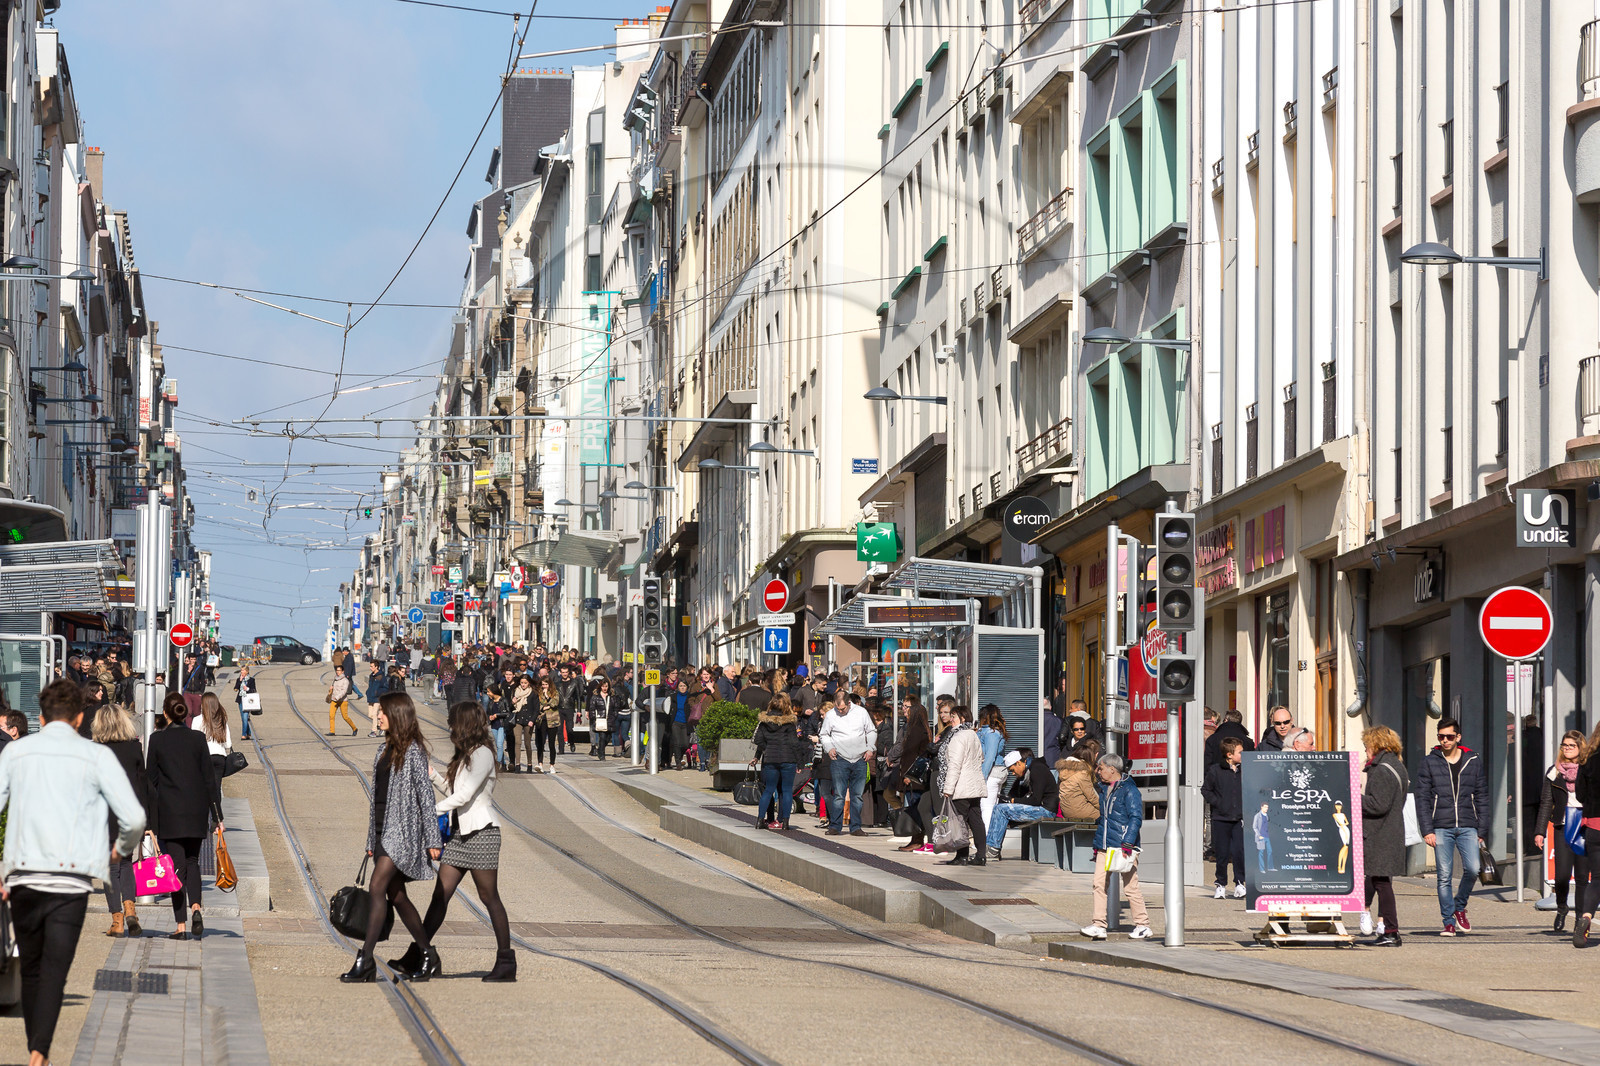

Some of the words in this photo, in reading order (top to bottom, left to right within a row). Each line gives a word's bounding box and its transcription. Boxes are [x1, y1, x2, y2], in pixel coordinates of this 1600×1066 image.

[583, 312, 604, 450] PRINTEMPS
[1013, 509, 1050, 525] éram
[1523, 527, 1569, 543] undiz
[1145, 633, 1167, 662] KING
[647, 672, 658, 680] 30
[1134, 691, 1140, 710] À
[1142, 693, 1157, 710] 100
[1133, 721, 1150, 731] CENTRE
[1139, 734, 1155, 745] ESPACE
[1271, 789, 1292, 800] LE
[1293, 789, 1332, 803] SPA
